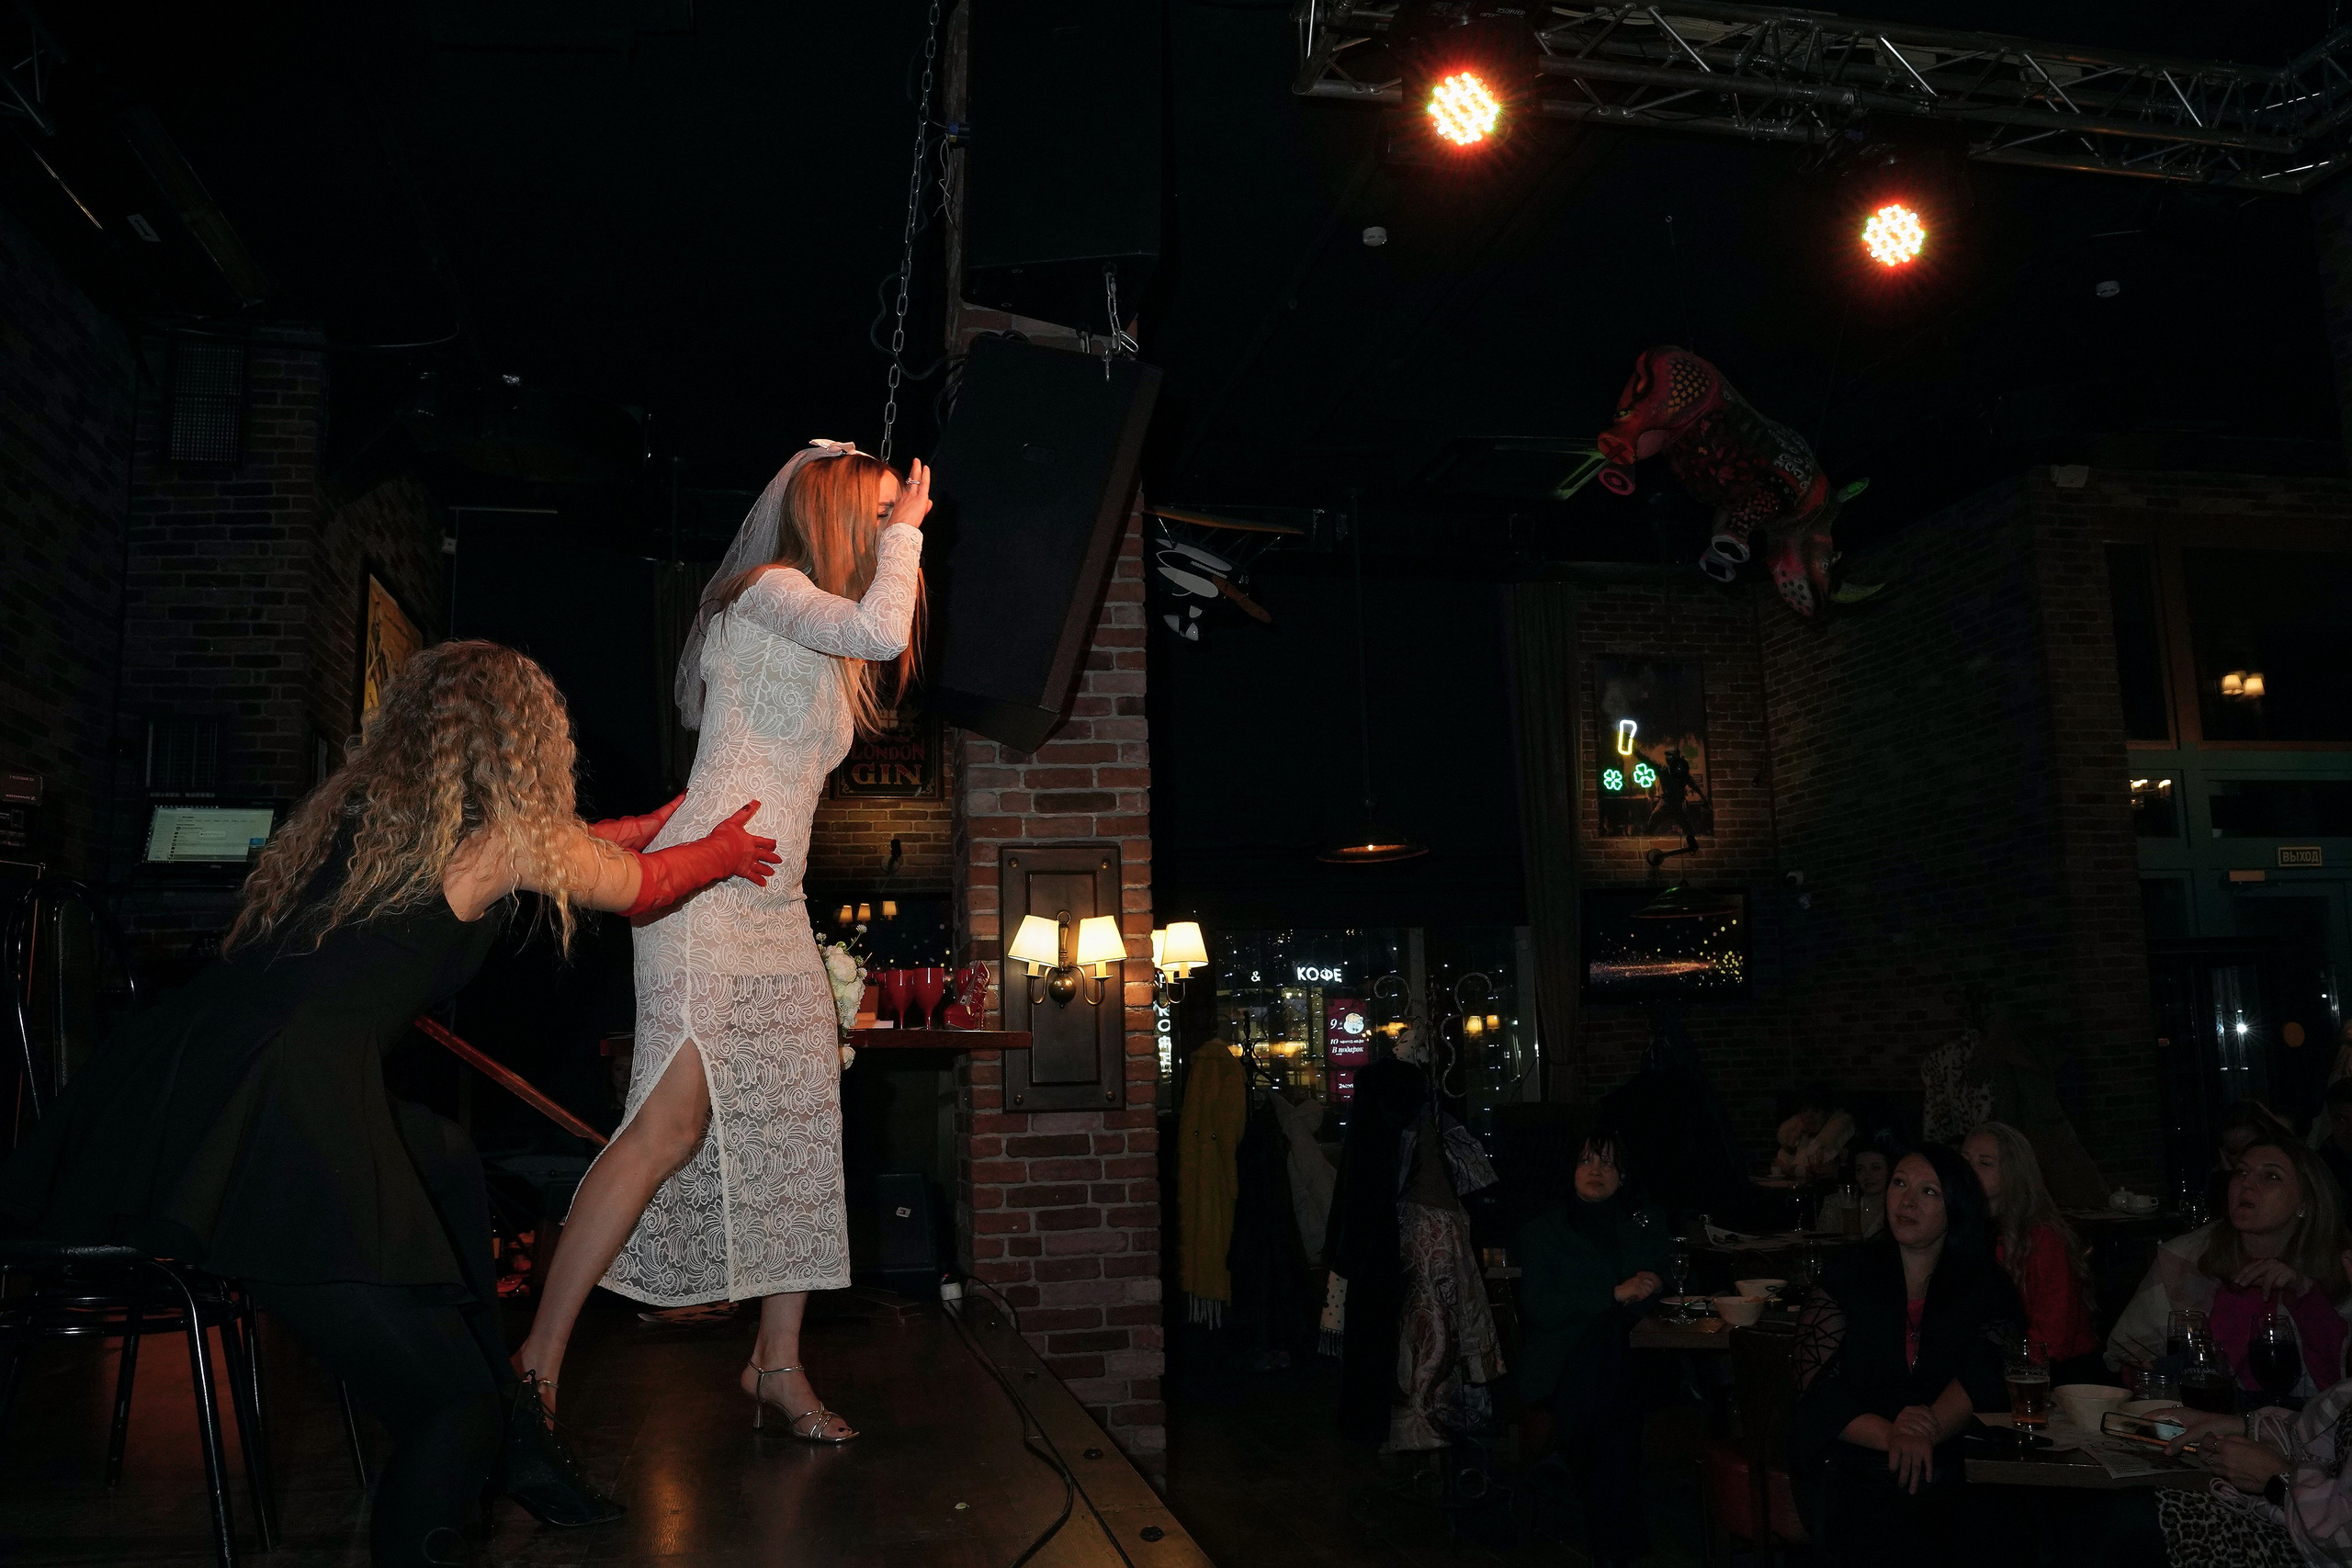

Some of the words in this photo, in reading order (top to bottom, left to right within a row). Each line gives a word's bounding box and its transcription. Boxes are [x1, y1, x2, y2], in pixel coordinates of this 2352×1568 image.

[851, 739, 926, 761] LONDON
[851, 762, 922, 786] GIN
[2282, 851, 2320, 863] ВЫХОД
[1250, 970, 1261, 982] &
[1296, 966, 1342, 983] КОФЕ
